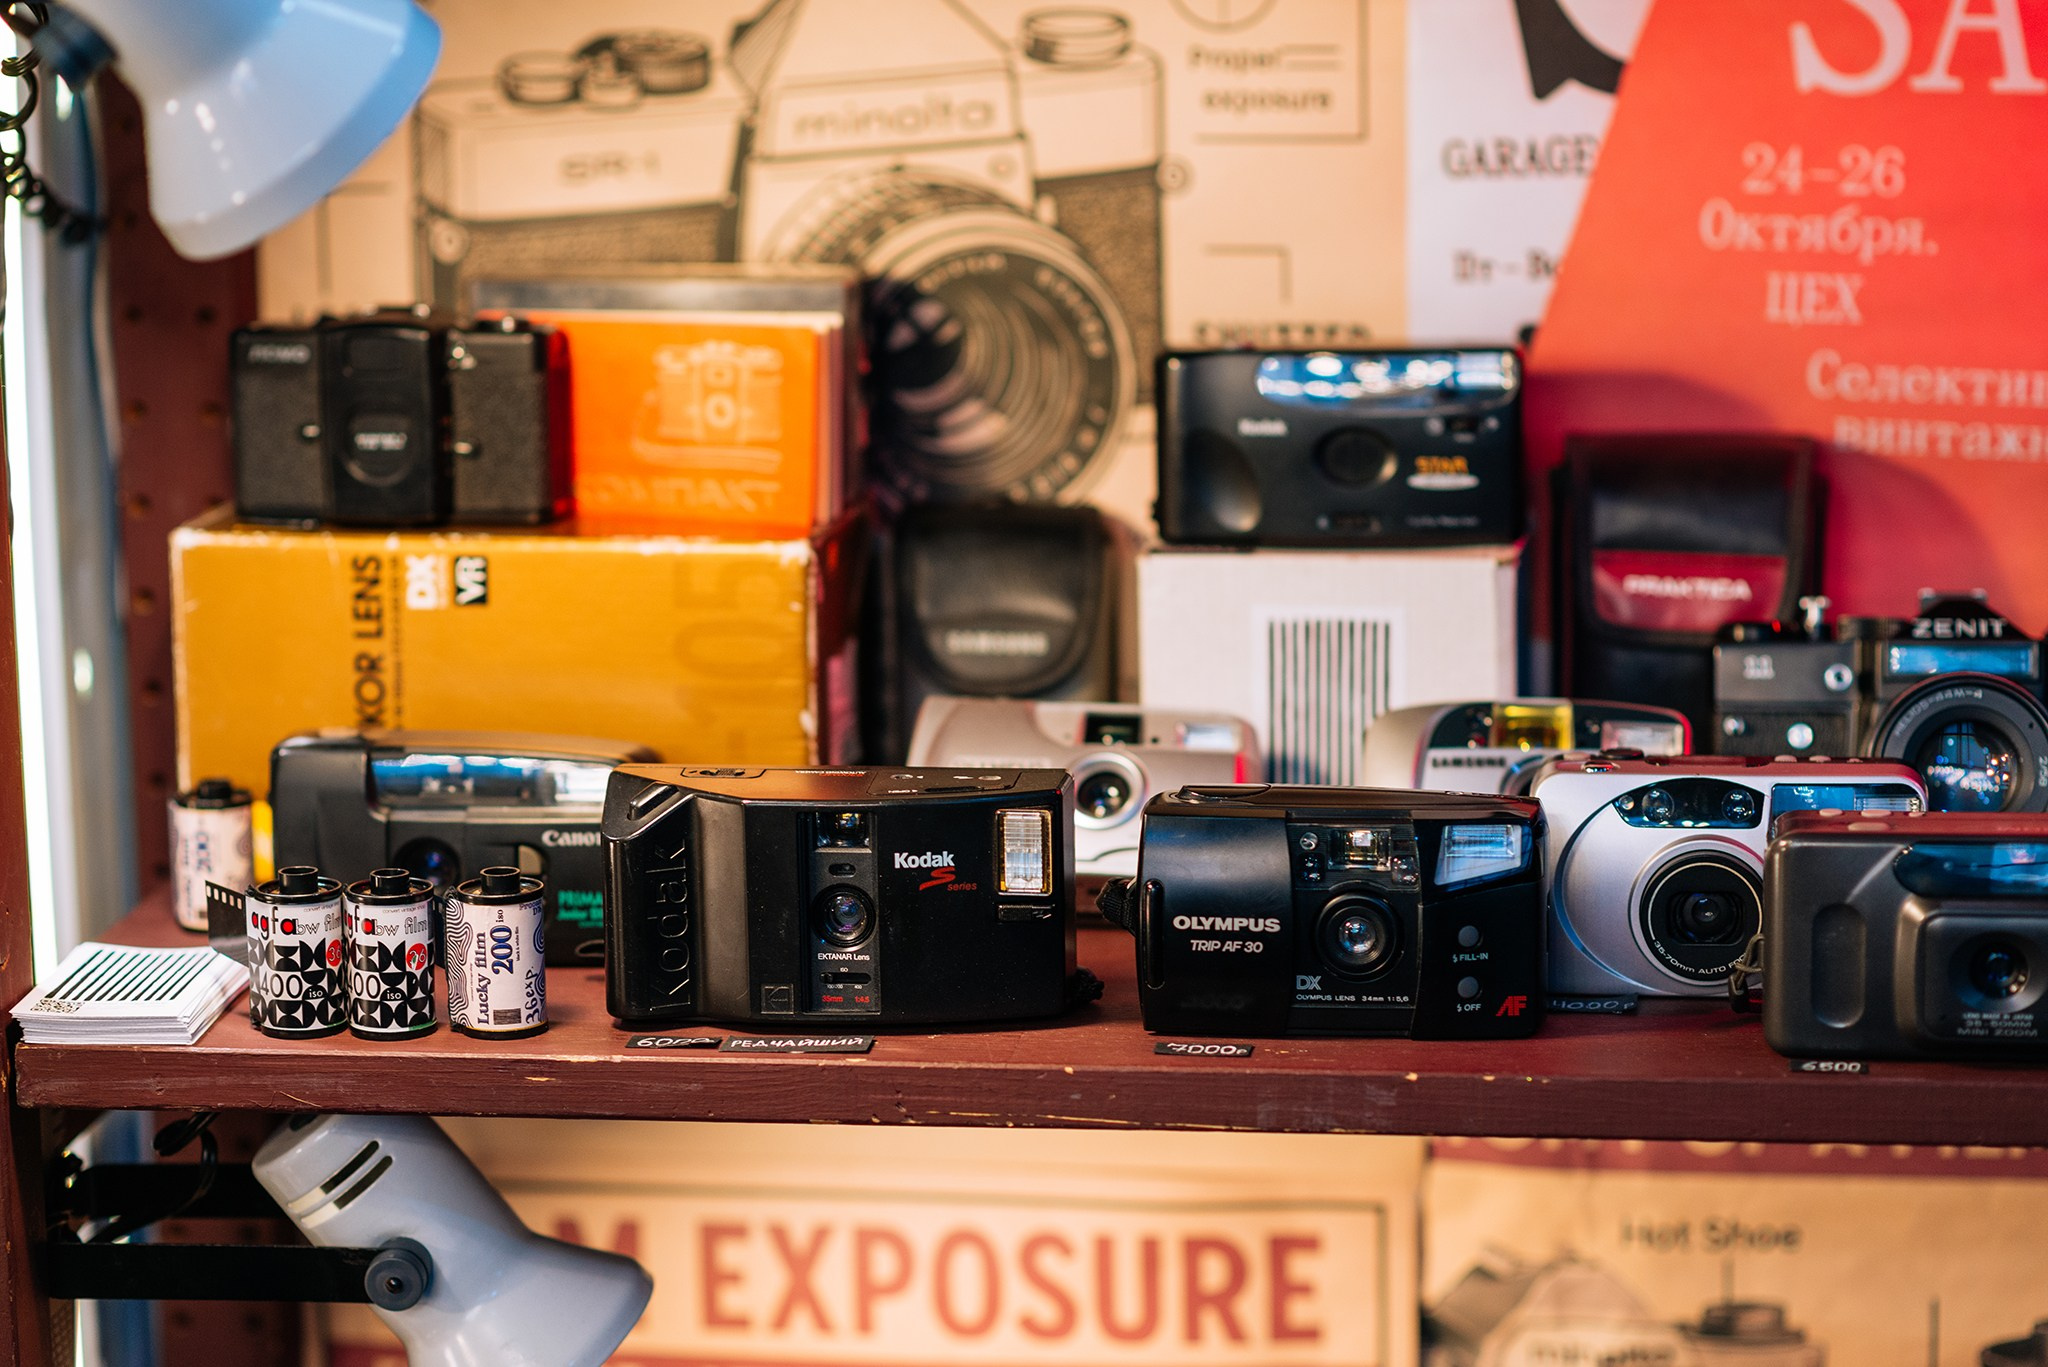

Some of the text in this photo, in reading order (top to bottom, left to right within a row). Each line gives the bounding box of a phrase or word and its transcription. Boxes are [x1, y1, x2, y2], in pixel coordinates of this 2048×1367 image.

[1700, 196, 1939, 267] Октября.
[1765, 270, 1863, 328] ЦЕХ
[354, 556, 382, 638] LENS
[1912, 618, 2005, 638] ZENIT
[1432, 757, 1506, 769] SAMSUNG
[894, 850, 955, 869] Kodak
[947, 881, 977, 891] series
[405, 916, 428, 934] film
[1173, 915, 1281, 933] OLYMPUS
[490, 909, 514, 975] 200 iso
[1190, 940, 1264, 953] TRIP AF 30
[1459, 952, 1489, 961] FILL-IN
[475, 932, 491, 1025] Lucky film
[1698, 965, 1726, 975] AUTO
[260, 971, 323, 999] 400 iso
[1296, 975, 1321, 990] DX
[387, 990, 401, 1000] iso
[1464, 1003, 1481, 1011] OFF
[1495, 995, 1527, 1016] AF
[731, 1037, 864, 1048] РЕДЧАЙШИЙ
[1801, 1061, 1861, 1071] 6500
[1621, 1216, 1803, 1251] Hot Shoe
[696, 1218, 1321, 1344] EXPOSURE
